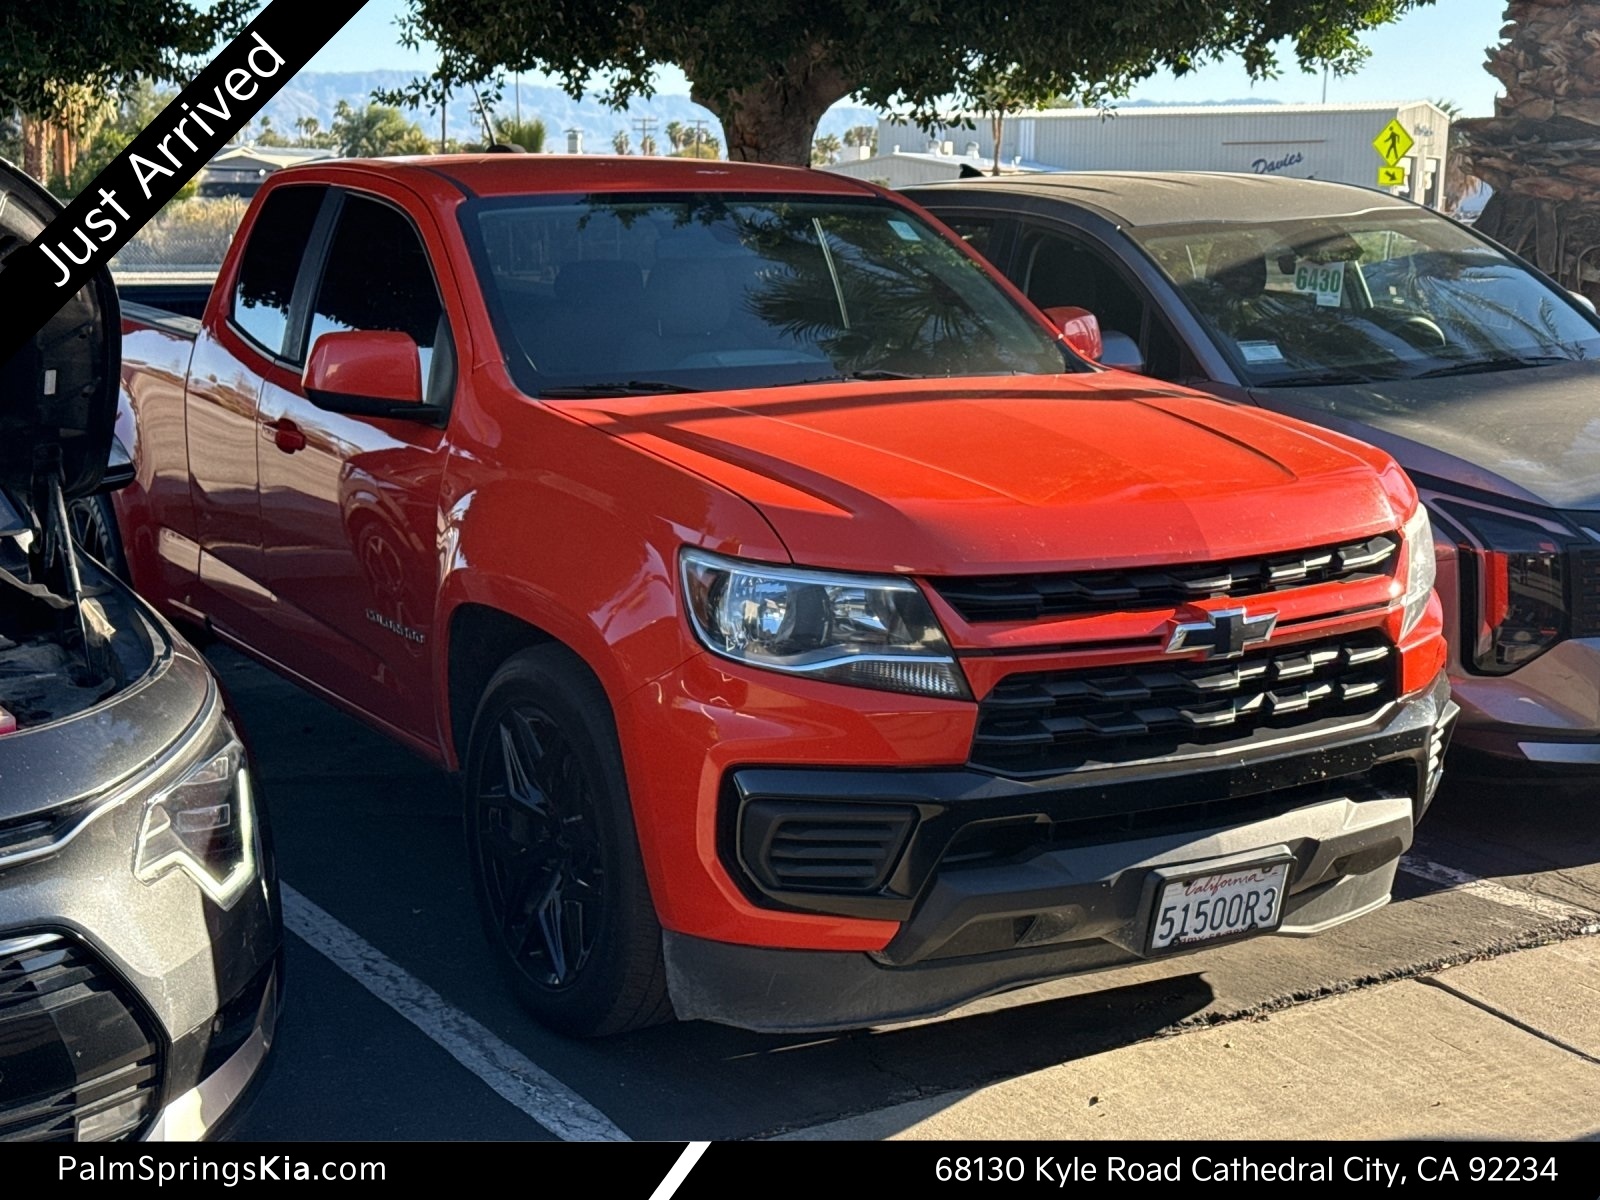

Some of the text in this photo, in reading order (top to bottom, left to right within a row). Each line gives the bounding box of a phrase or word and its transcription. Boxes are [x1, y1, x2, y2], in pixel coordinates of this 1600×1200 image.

[1252, 151, 1304, 175] Davies
[1295, 266, 1340, 293] 6430
[1184, 873, 1265, 897] California
[1158, 887, 1278, 941] 51500R3
